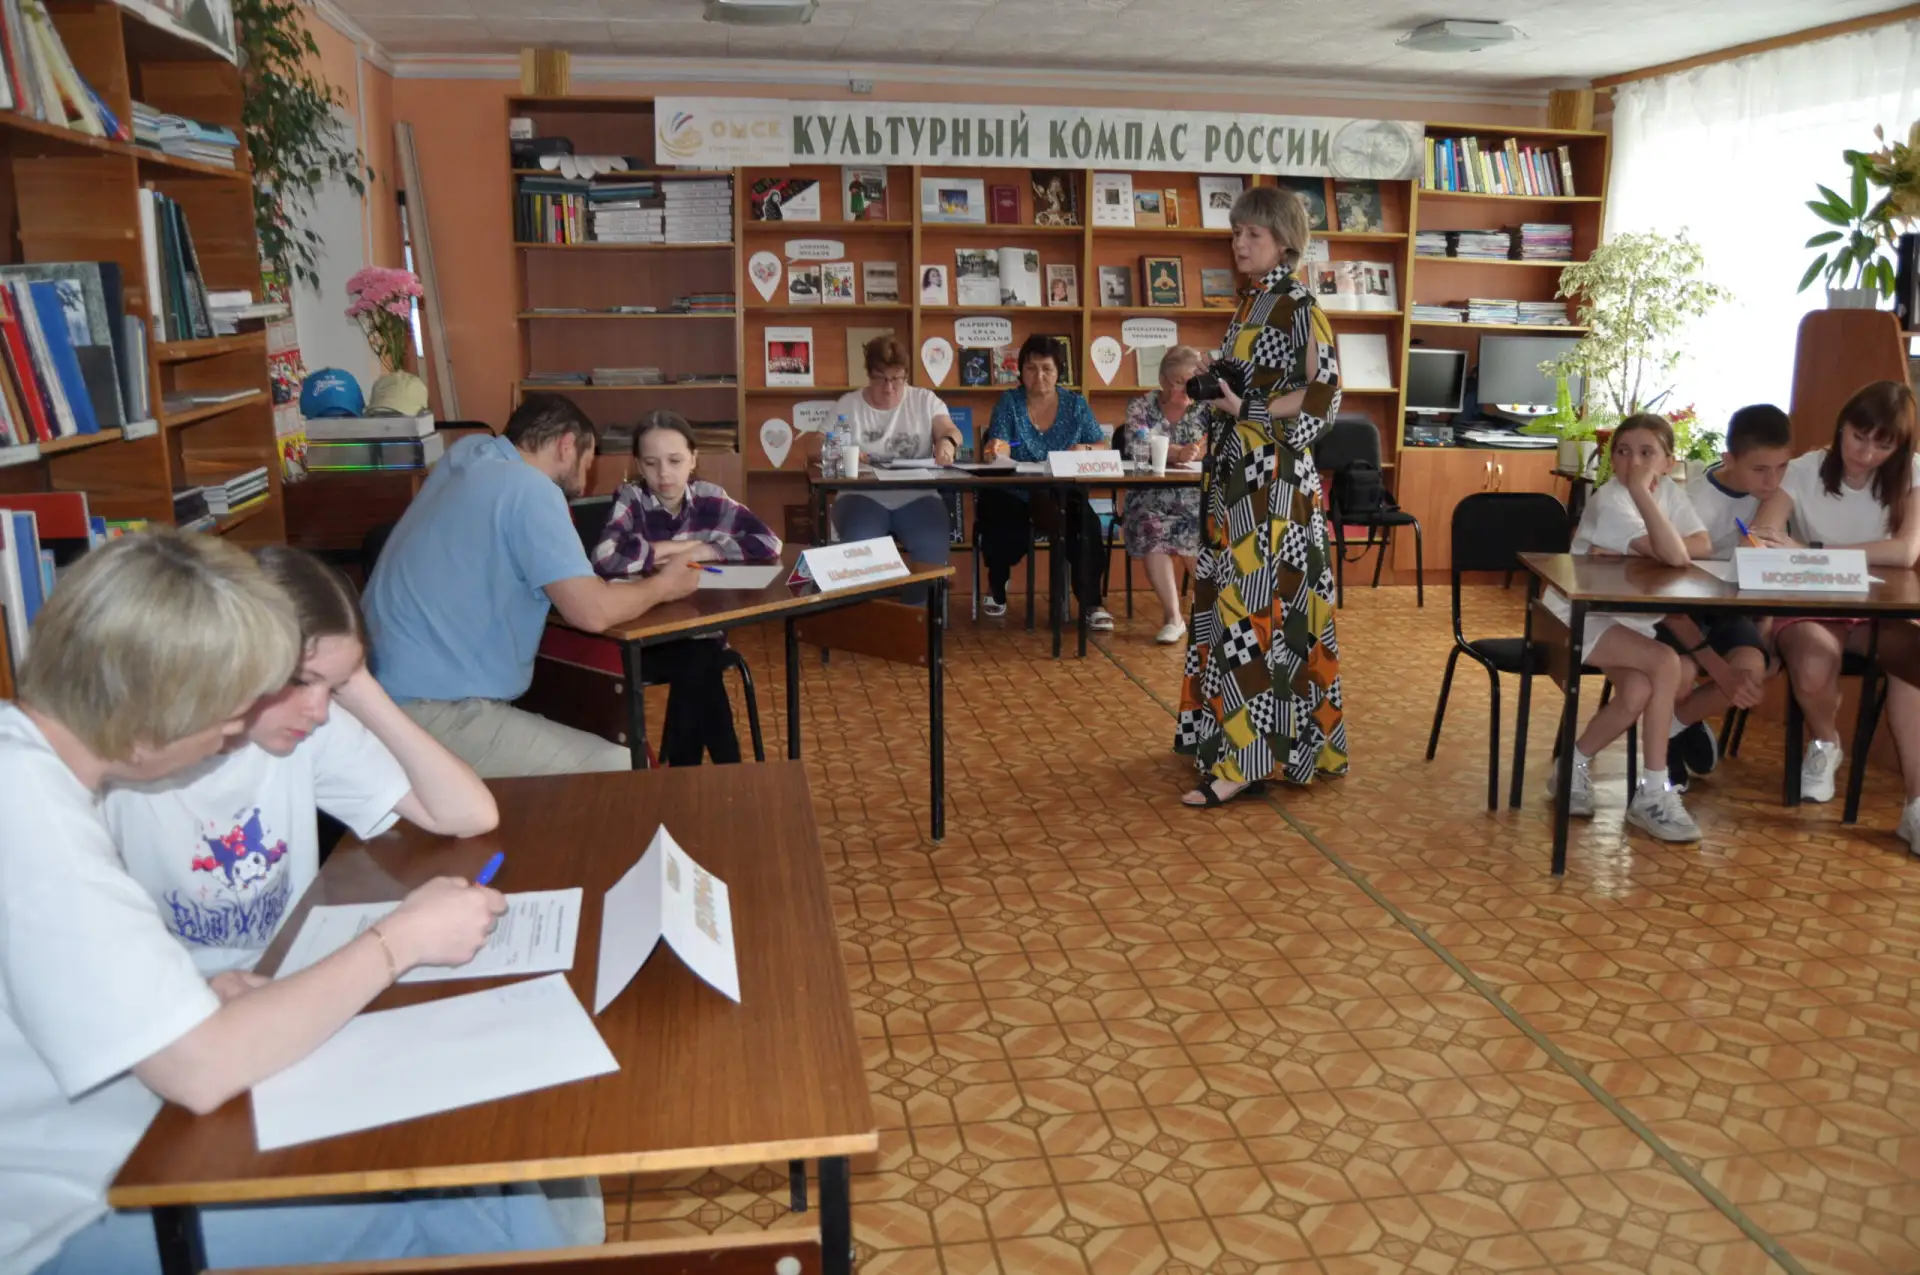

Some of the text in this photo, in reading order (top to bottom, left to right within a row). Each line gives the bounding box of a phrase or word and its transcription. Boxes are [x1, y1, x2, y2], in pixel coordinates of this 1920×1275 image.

[792, 110, 1330, 167] КУЛЬТУРНЫЙ КОМПАС РОССИИ
